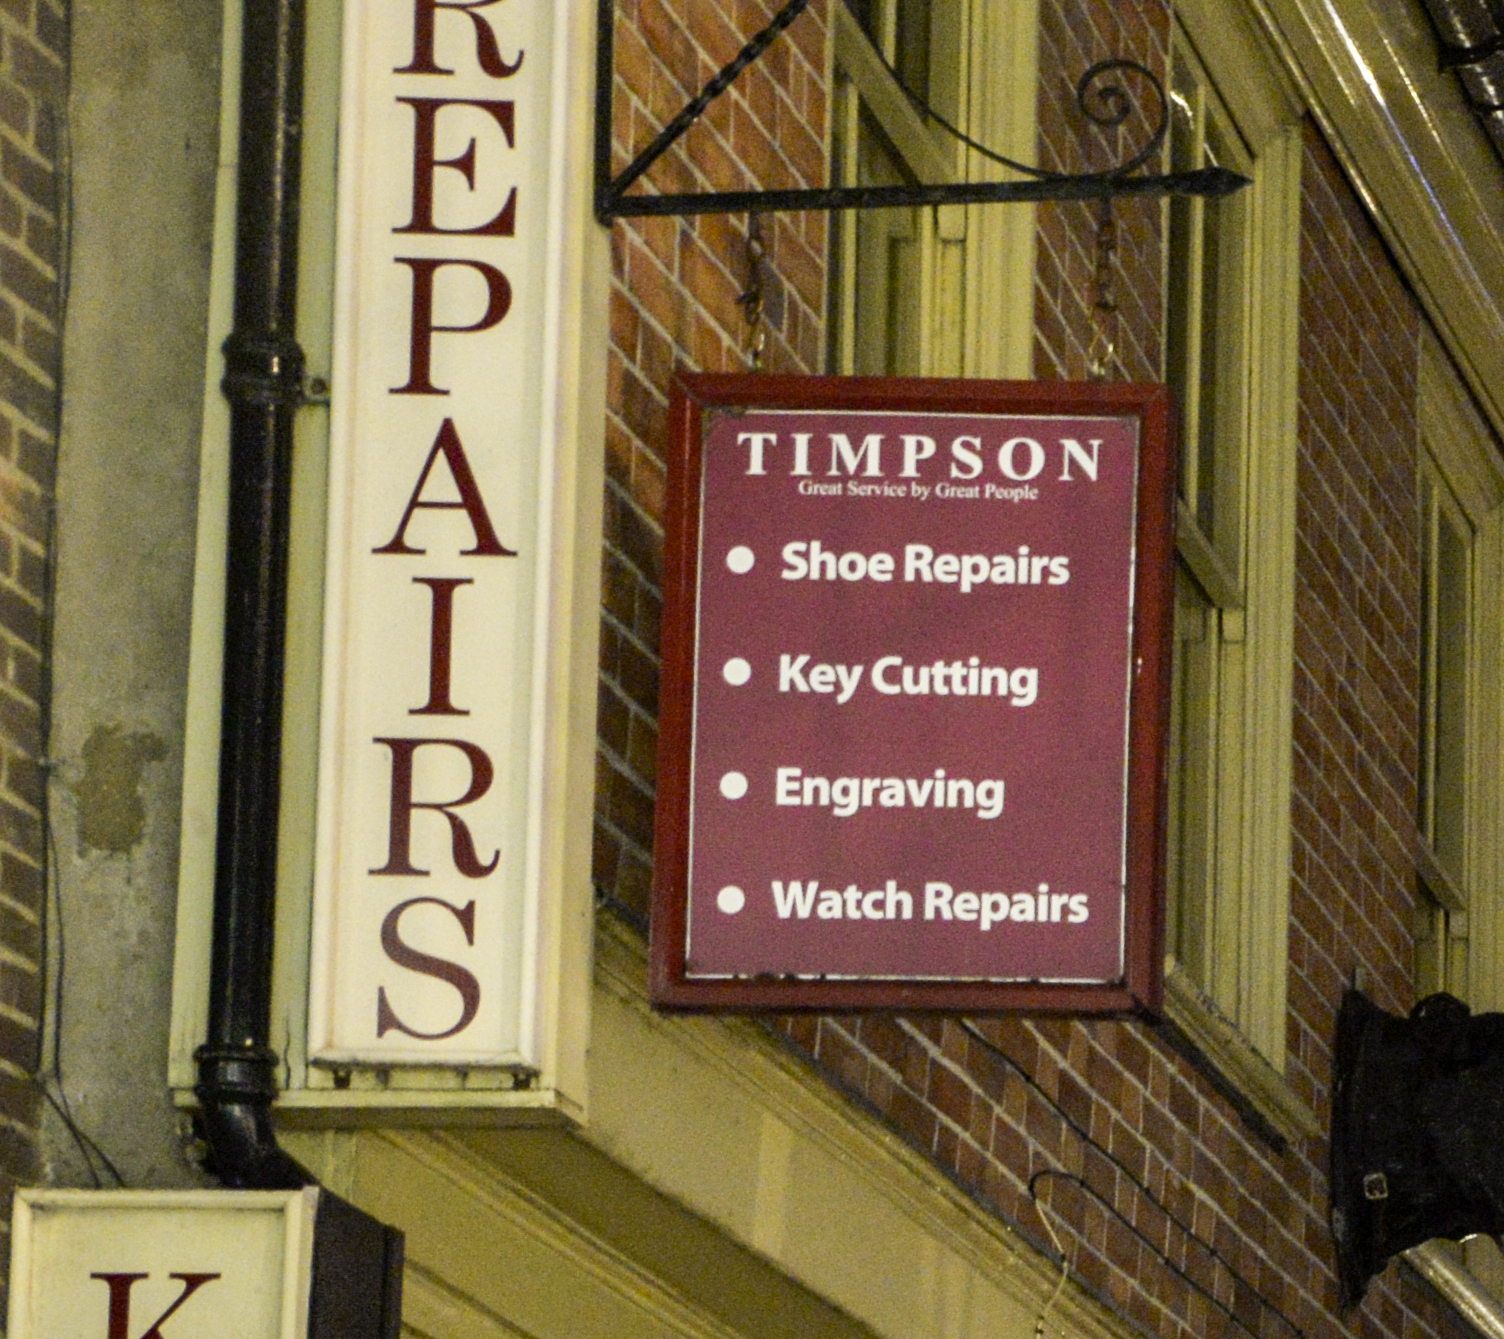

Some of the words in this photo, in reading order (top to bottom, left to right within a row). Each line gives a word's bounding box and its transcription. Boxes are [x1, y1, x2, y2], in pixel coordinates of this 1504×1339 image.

[736, 430, 1105, 483] TIMPSON
[798, 479, 842, 497] Great
[848, 480, 907, 498] Service
[912, 481, 932, 501] by
[935, 483, 980, 499] Great
[985, 484, 1039, 503] People
[366, 0, 528, 1042] REPAIRS
[780, 541, 892, 585] Shoe
[903, 545, 1071, 592] Repairs
[777, 655, 863, 702] Key
[870, 657, 1040, 707] Cutting
[774, 768, 1006, 820] Engraving
[772, 881, 913, 923] Watch
[923, 883, 1090, 928] Repairs
